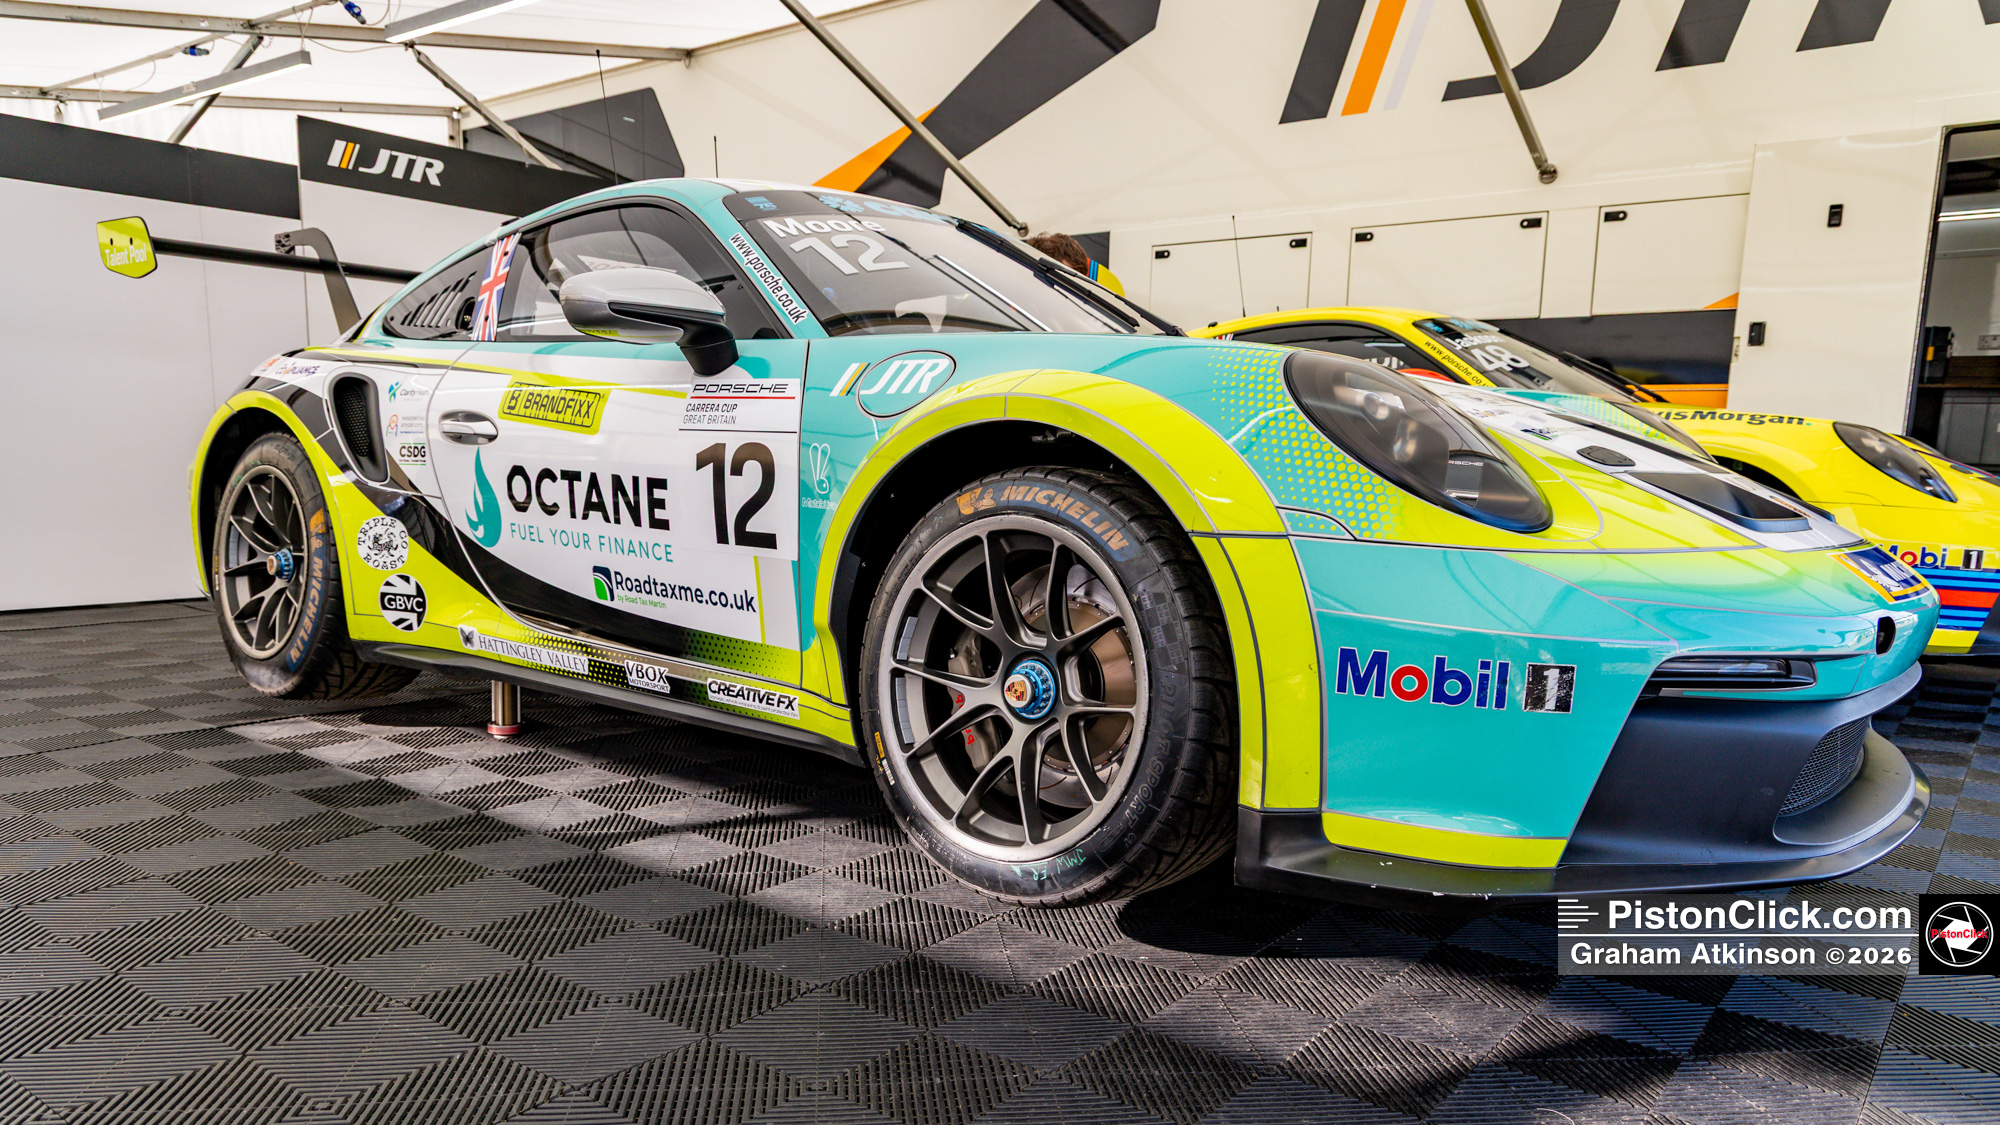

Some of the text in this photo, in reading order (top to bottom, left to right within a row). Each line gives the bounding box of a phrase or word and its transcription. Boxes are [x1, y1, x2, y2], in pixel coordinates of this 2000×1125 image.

[358, 148, 445, 187] JTR
[763, 218, 886, 238] Moore
[105, 243, 147, 268] Talent Pool
[790, 234, 910, 275] 12
[730, 233, 808, 324] www.porsche.co.uk
[1470, 345, 1530, 371] 48
[692, 384, 789, 393] PORSCHE
[860, 358, 951, 395] JTR
[523, 392, 595, 420] BRANDFIXX
[683, 414, 737, 425] GREAT BRITAIN
[685, 403, 738, 413] CARRERA CUP
[399, 445, 426, 458] CSDG
[506, 464, 671, 532] OCTANE
[695, 442, 778, 550] 12
[357, 517, 397, 546] TRIPLE
[1000, 484, 1129, 552] MICHELIN
[510, 522, 674, 563] FUEL YOUR FINANCE
[363, 553, 406, 570] ROAST
[384, 594, 424, 612] GBVC
[614, 570, 757, 613] Roadtaxme.co.uk
[617, 593, 625, 604] by
[639, 597, 648, 606] Tax
[648, 600, 667, 609] Martin
[290, 556, 324, 664] MICHELIN
[478, 635, 587, 674] HATTINGLEY VALLEY
[625, 661, 668, 684] VBOX
[628, 678, 671, 693] MOTORSPORT
[1335, 646, 1511, 711] Mobil
